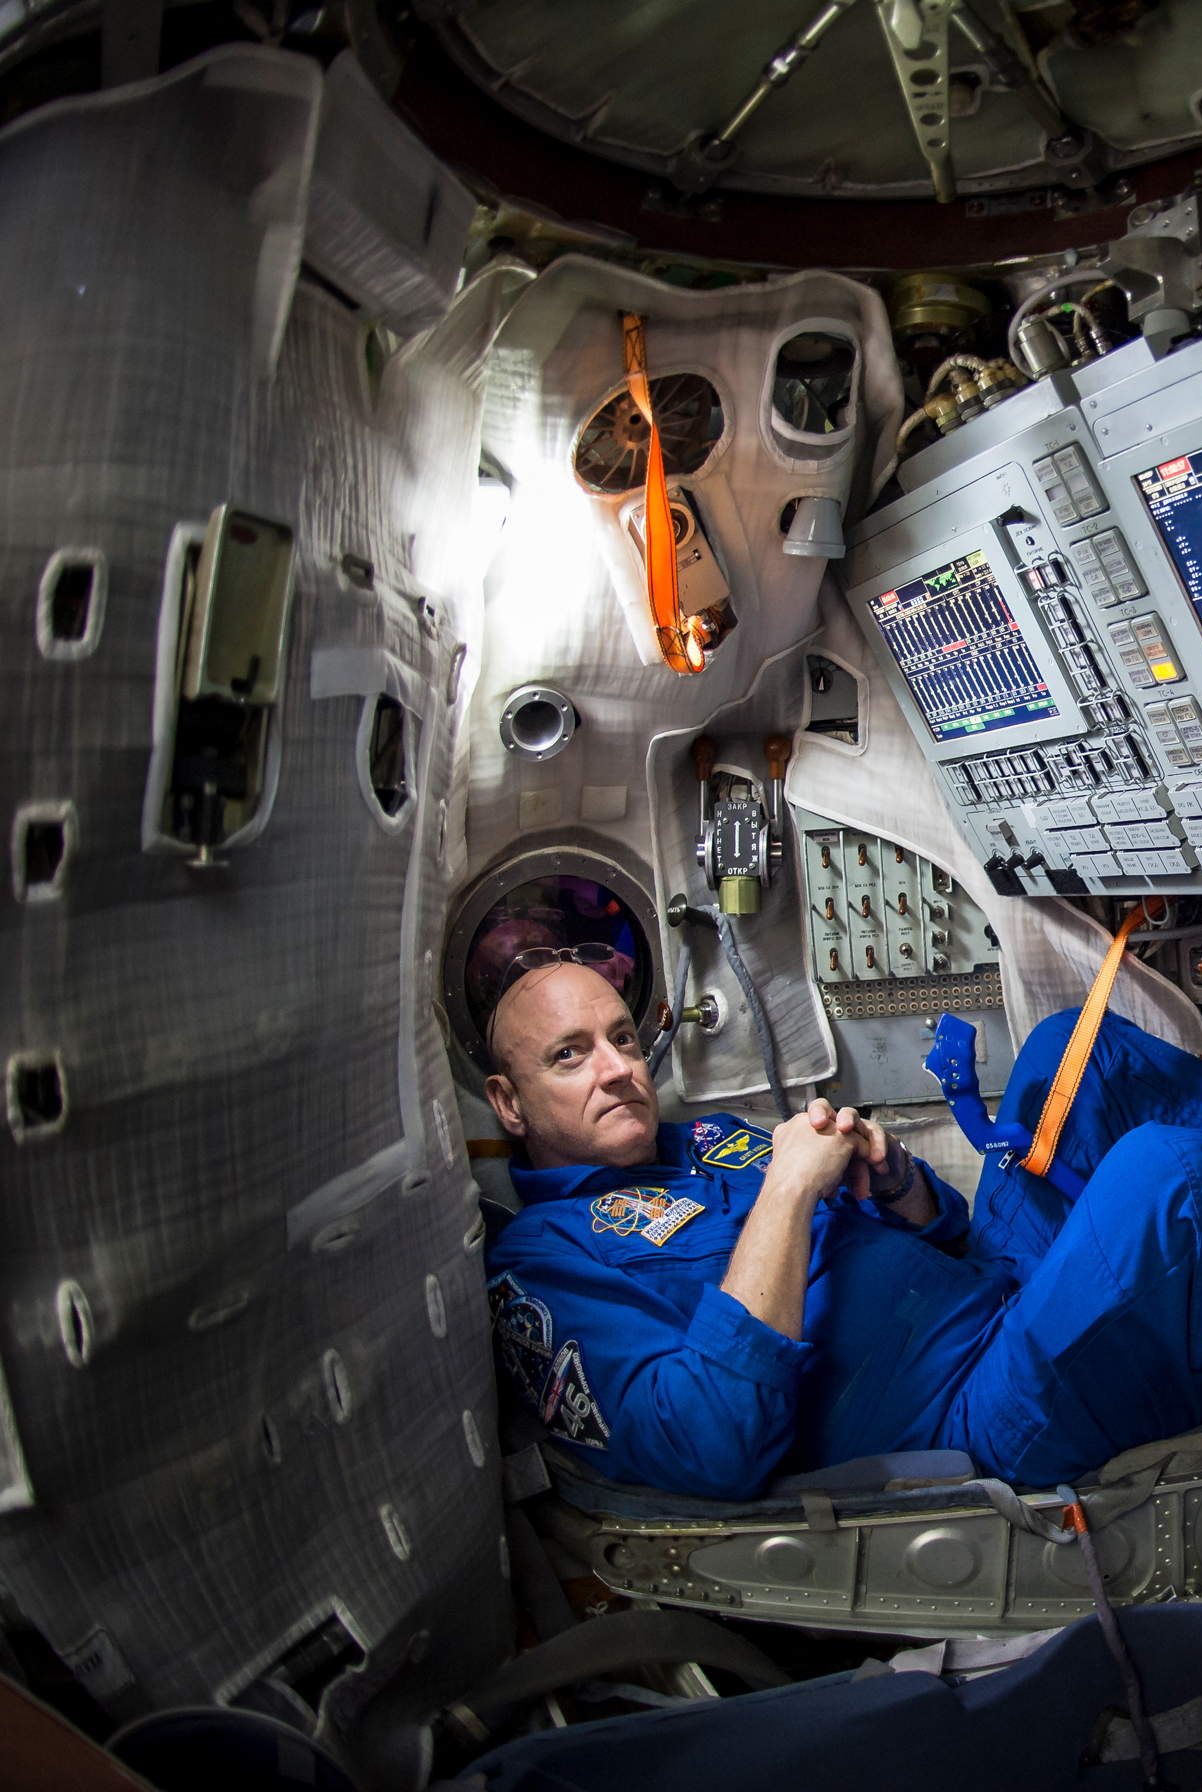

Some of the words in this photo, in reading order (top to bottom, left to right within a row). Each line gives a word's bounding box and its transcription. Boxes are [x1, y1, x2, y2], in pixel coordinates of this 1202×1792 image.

[727, 803, 748, 811] ЗАКР
[727, 867, 748, 875] ОТКР
[560, 1382, 591, 1438] 46
